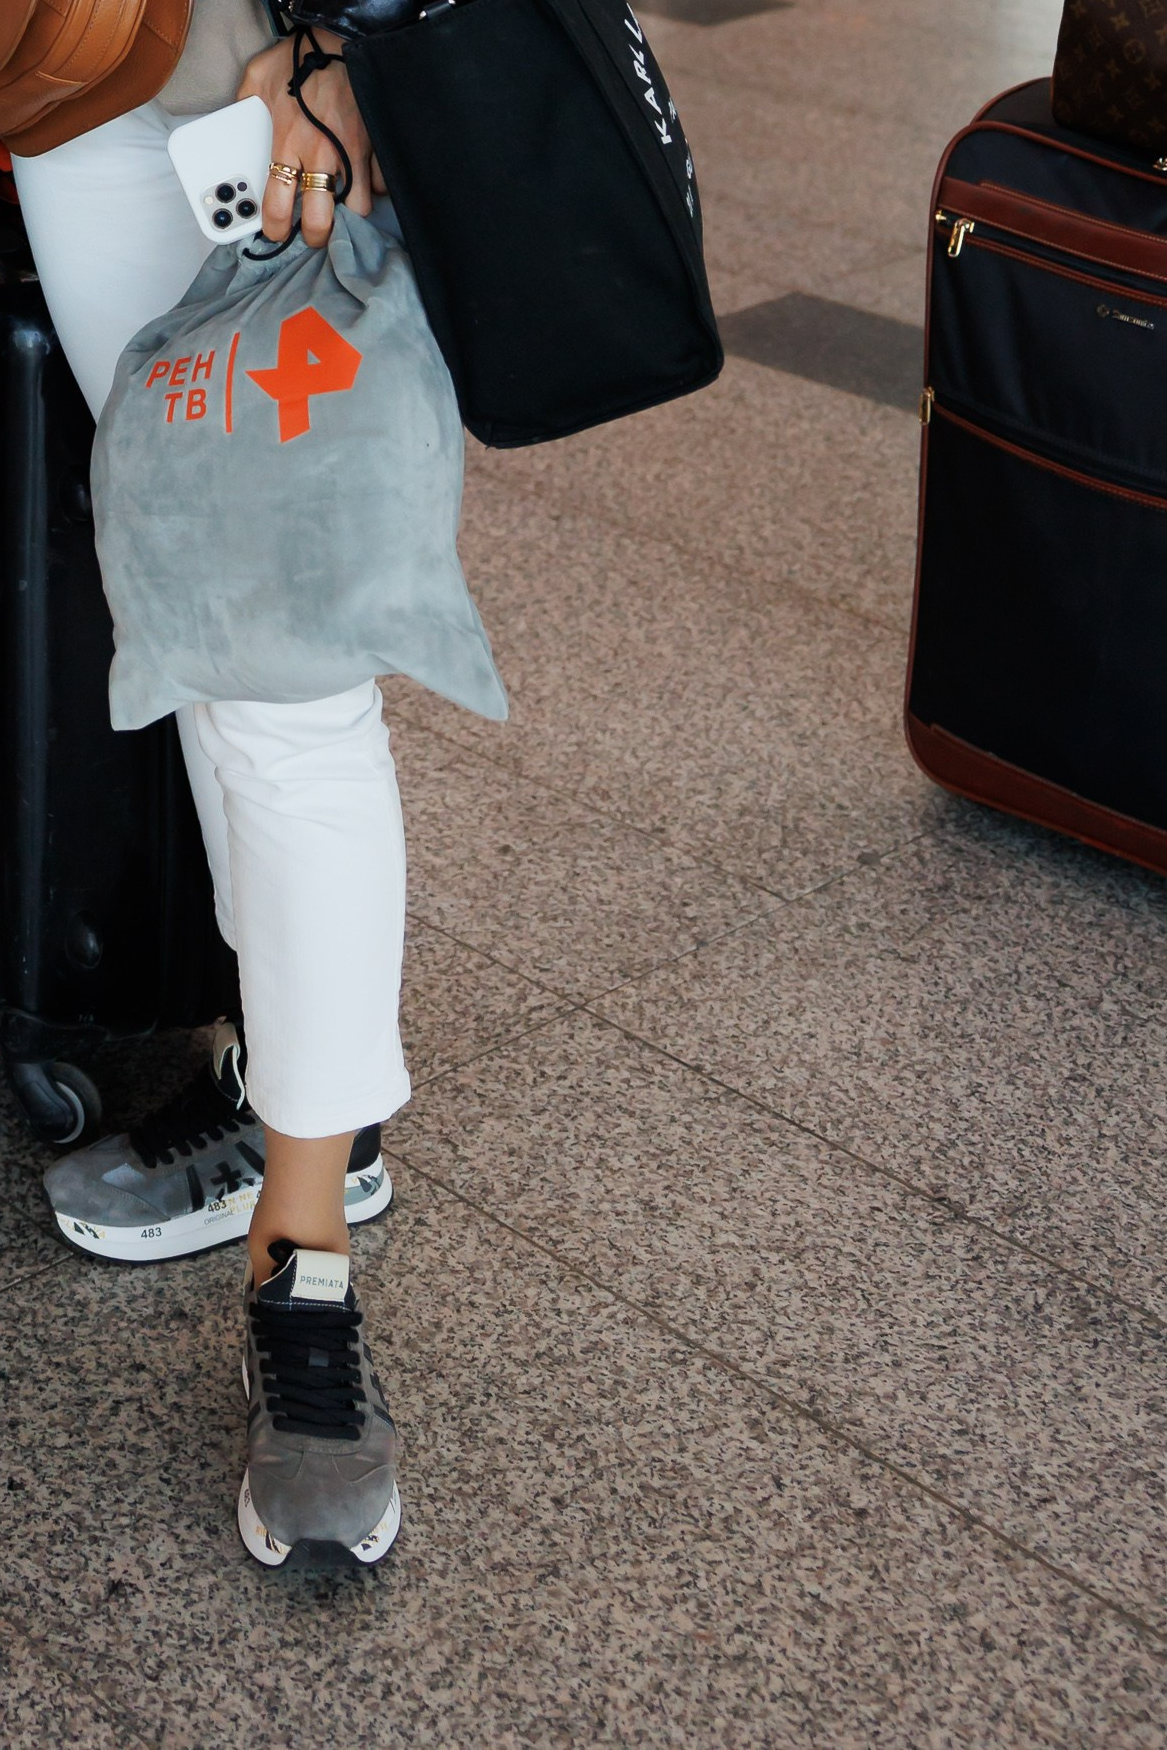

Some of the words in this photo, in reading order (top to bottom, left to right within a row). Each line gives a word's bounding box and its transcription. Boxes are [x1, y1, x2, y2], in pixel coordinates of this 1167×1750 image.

[629, 43, 673, 145] KARL
[146, 350, 216, 388] РЕН
[164, 388, 207, 424] ТВ
[207, 1199, 227, 1213] 483
[140, 1226, 163, 1239] 483
[299, 1275, 344, 1289] PREMIATA
